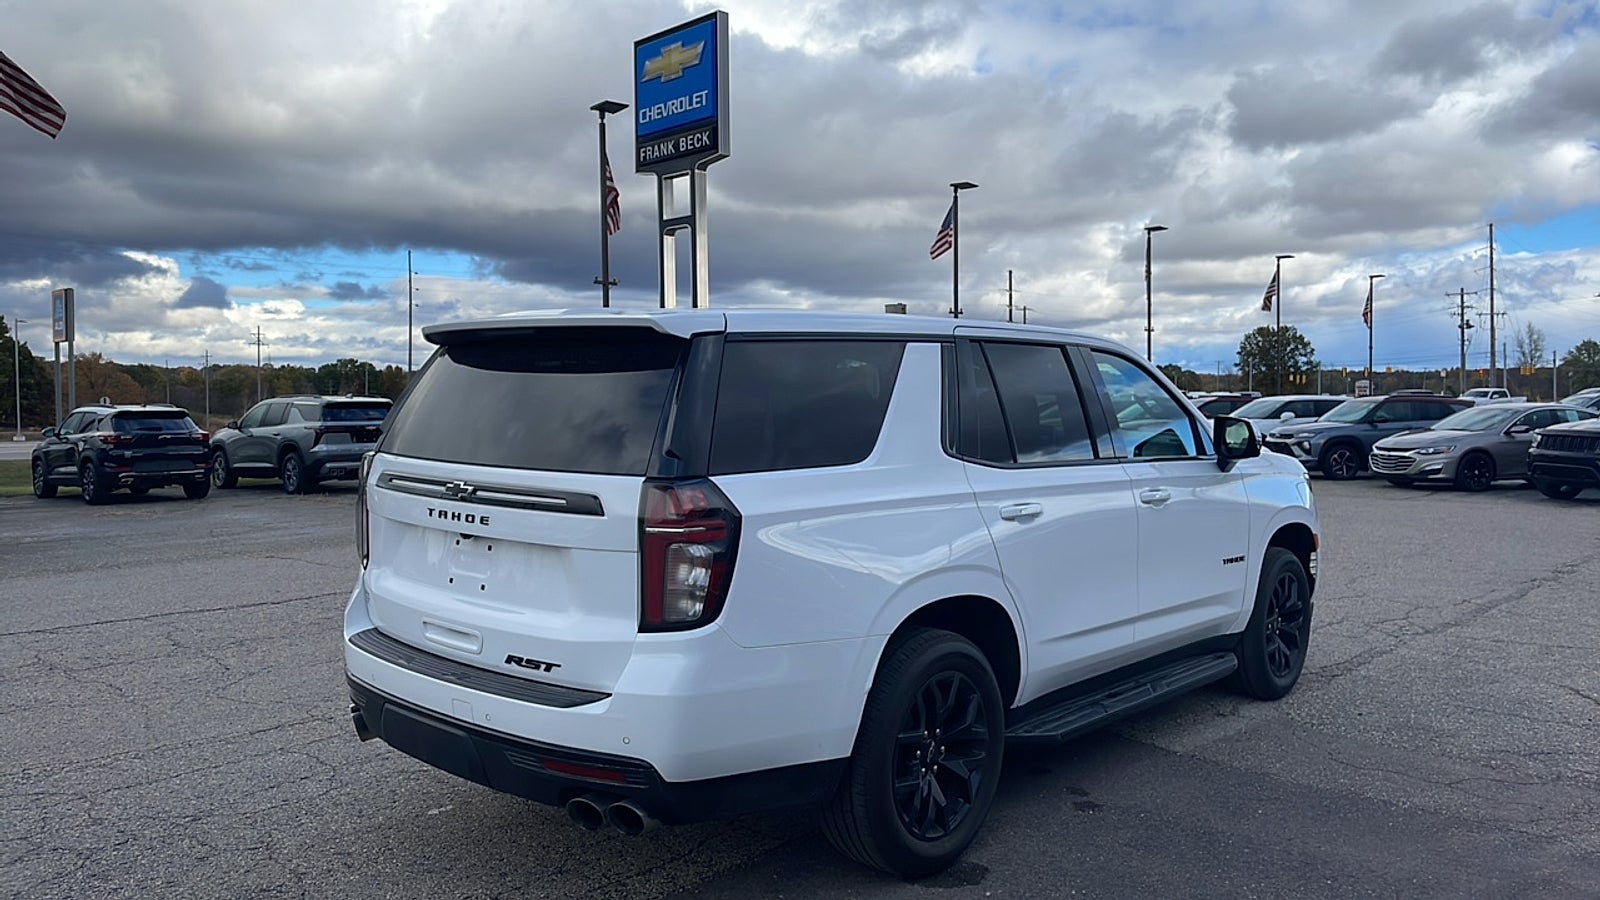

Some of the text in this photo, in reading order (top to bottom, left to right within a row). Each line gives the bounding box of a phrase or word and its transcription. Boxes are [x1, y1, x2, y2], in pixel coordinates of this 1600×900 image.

[639, 90, 708, 124] CHEVROLET
[640, 131, 710, 162] FRANK BECK
[426, 507, 491, 527] TAHOE
[504, 654, 562, 673] RST
